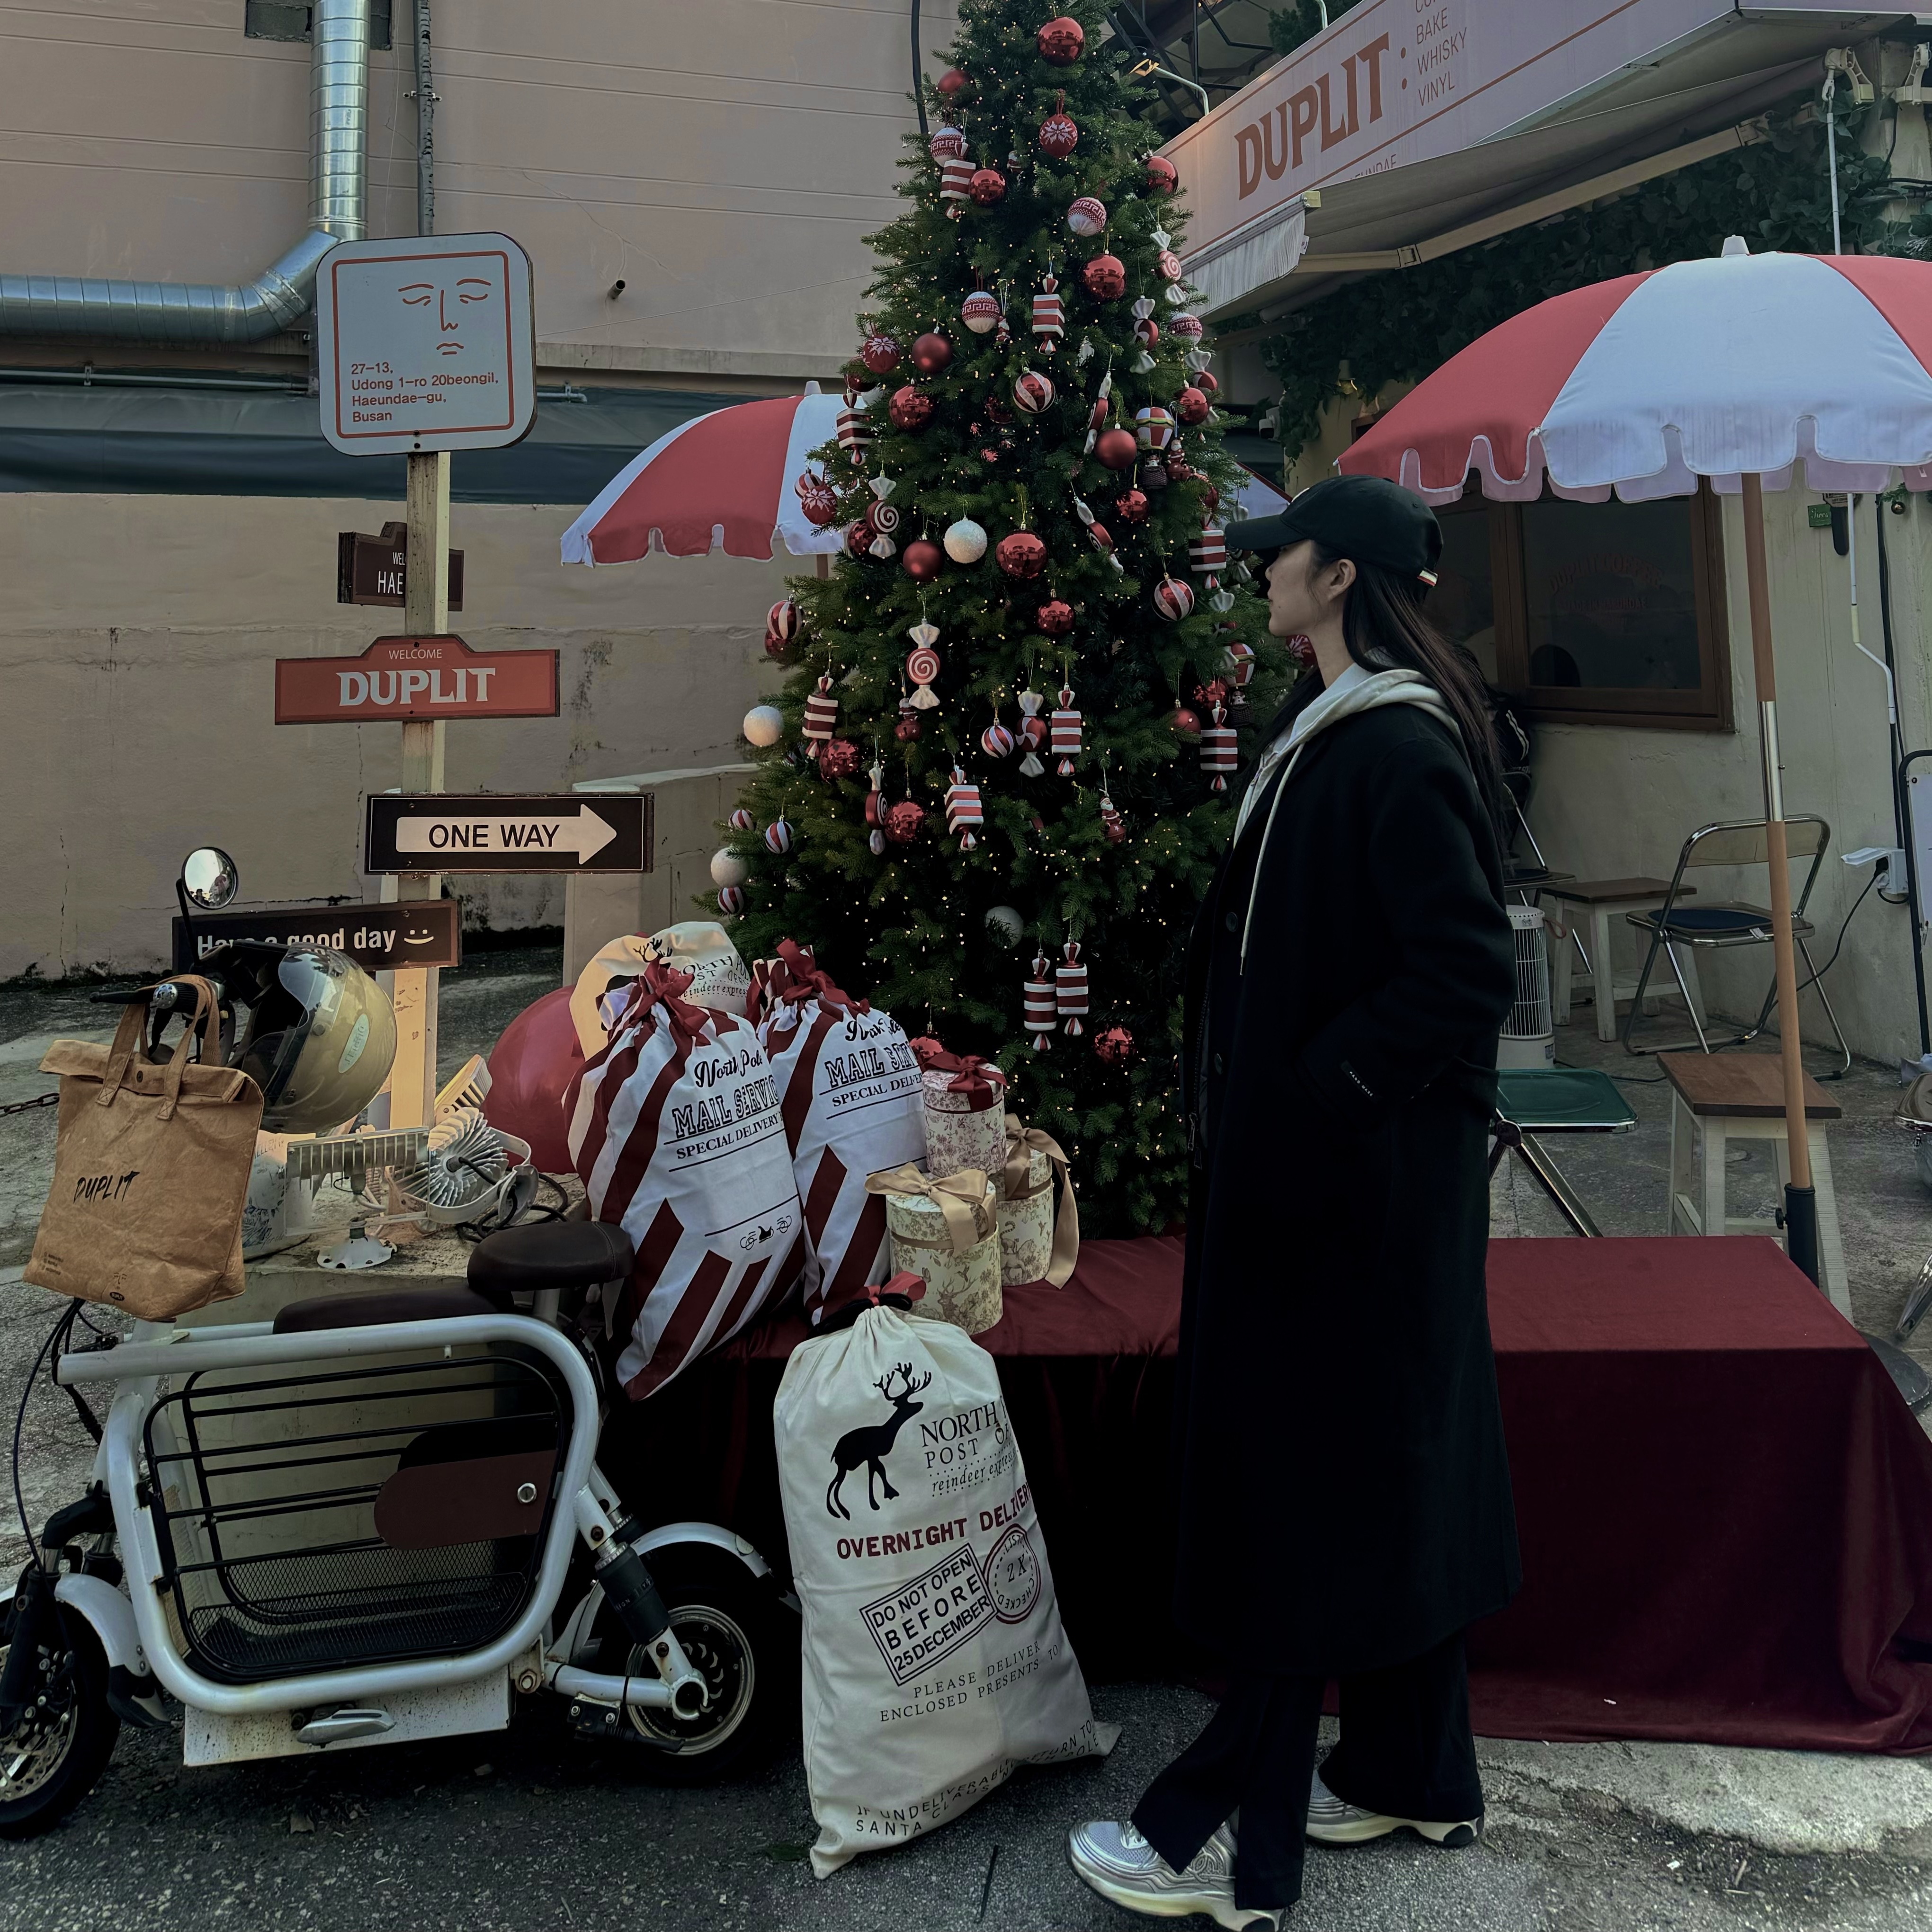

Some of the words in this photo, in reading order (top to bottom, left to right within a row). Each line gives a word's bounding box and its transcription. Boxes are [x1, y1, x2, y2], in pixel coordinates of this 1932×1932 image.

[1416, 7, 1449, 45] BAKE
[1417, 27, 1467, 76] WHISKY
[1418, 71, 1455, 107] VINYL
[1234, 31, 1389, 201] DUPLIT
[351, 362, 394, 375] 27-13,
[351, 379, 393, 392] Udong
[398, 377, 427, 389] 1-ro
[431, 372, 499, 387] 20beongil,
[352, 392, 447, 407] Haeundae-gu,
[352, 410, 392, 423] Busan
[377, 570, 403, 595] HAE
[389, 649, 442, 660] WELCOME
[336, 668, 496, 706] DUPLIT
[429, 824, 488, 847] ONE
[500, 824, 560, 847] WAY
[354, 926, 396, 953] day
[680, 956, 733, 976] ORTH
[680, 981, 720, 998] eindeer
[694, 1056, 739, 1087] North
[824, 1047, 885, 1088] MAIL
[832, 1084, 888, 1107] SPECIAL
[671, 1095, 733, 1139] MAIL
[676, 1132, 734, 1159] SPECIAL
[736, 1113, 779, 1140] DELIVERY
[73, 1170, 140, 1203] DUPLIT
[919, 1401, 998, 1447] NORTH
[924, 1438, 978, 1469] POST
[932, 1465, 985, 1492] reindeer
[837, 1518, 967, 1559] OVERNIGHT
[871, 1606, 896, 1628] DO
[898, 1584, 929, 1614] NOT
[931, 1554, 972, 1591] OPEN
[997, 1577, 1035, 1611] CHECKED
[884, 1574, 982, 1650] BEFORE
[912, 1594, 991, 1660] DECEMBER
[880, 1692, 968, 1722] ENCLOSED
[978, 1657, 1040, 1699] PRESENTS
[1048, 1644, 1059, 1660] TO
[914, 1672, 977, 1698] PLEASE
[987, 1641, 1041, 1677] DELIVER
[1024, 1733, 1077, 1761] ETURN
[855, 1819, 922, 1837] SANTA
[931, 1784, 990, 1819] CLAUS
